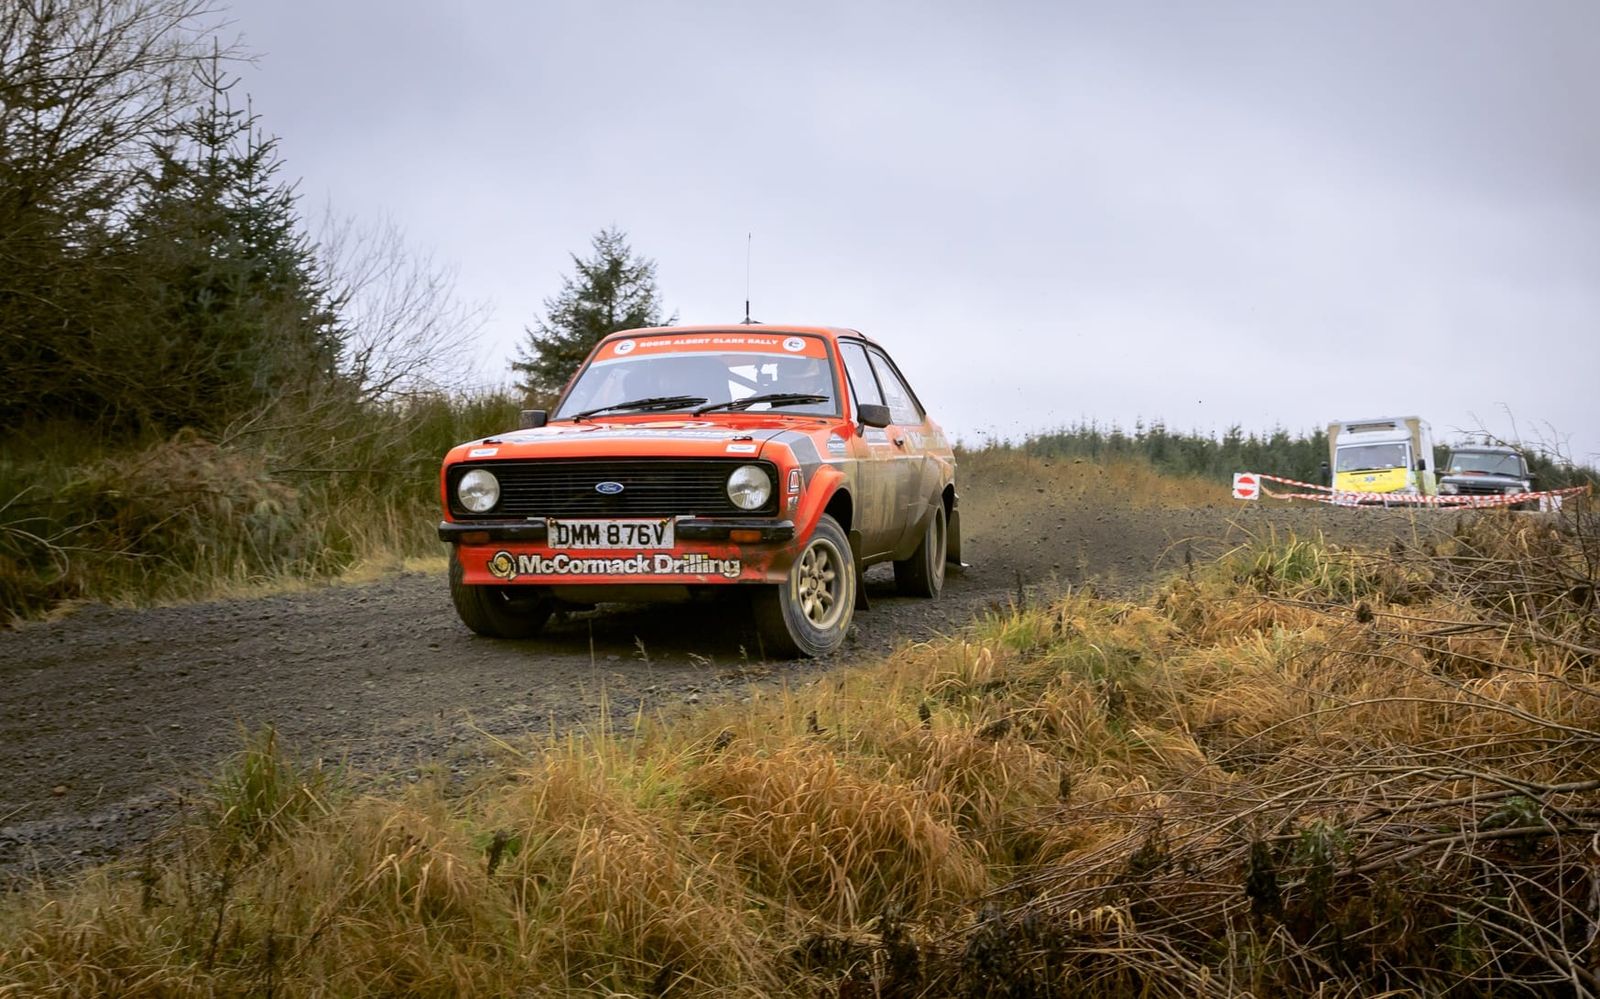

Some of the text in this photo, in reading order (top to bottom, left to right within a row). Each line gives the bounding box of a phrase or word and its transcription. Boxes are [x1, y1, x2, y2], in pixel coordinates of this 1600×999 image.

[673, 338, 710, 346] ALBERT
[557, 524, 666, 546] DMM 876V
[518, 554, 741, 578] McCormack Drilling
